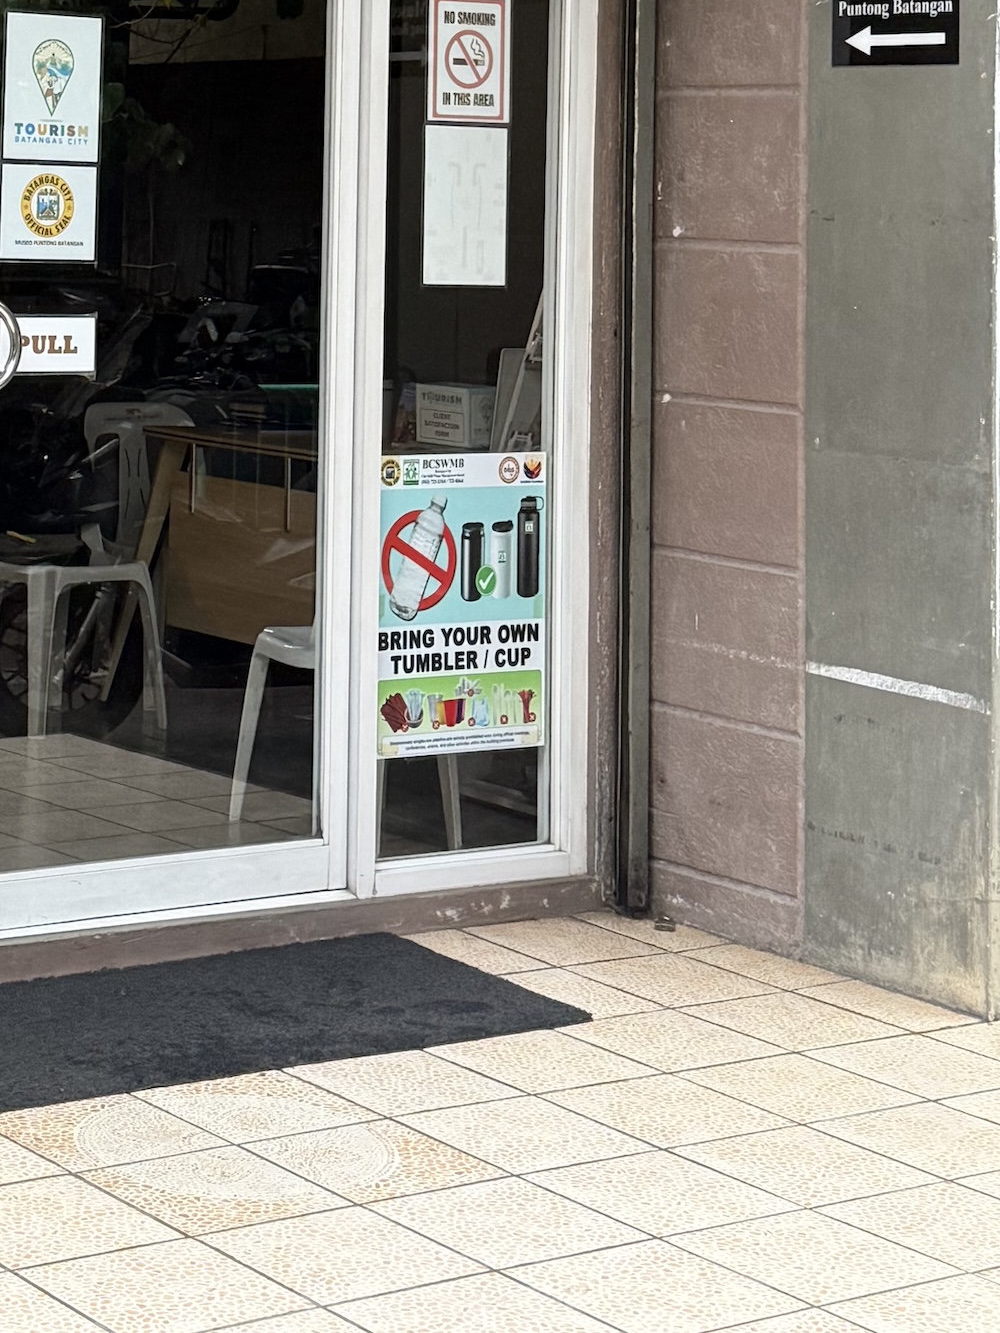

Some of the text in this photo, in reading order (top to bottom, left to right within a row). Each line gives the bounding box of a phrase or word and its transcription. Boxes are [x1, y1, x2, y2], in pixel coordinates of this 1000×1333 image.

[838, 1, 889, 19] Puntong
[444, 11, 496, 26] NO SMOKING
[442, 92, 494, 107] IN THIS AREA
[14, 123, 89, 137] TOURISM
[14, 136, 63, 145] BATANGAS
[24, 175, 74, 202] BATANGAS CITY
[24, 213, 71, 236] OFFICIAL SEAL
[422, 459, 465, 469] BCSWMB
[378, 623, 540, 652] BRING YOUR OWN
[390, 647, 532, 674] TUMBLER / CUP
